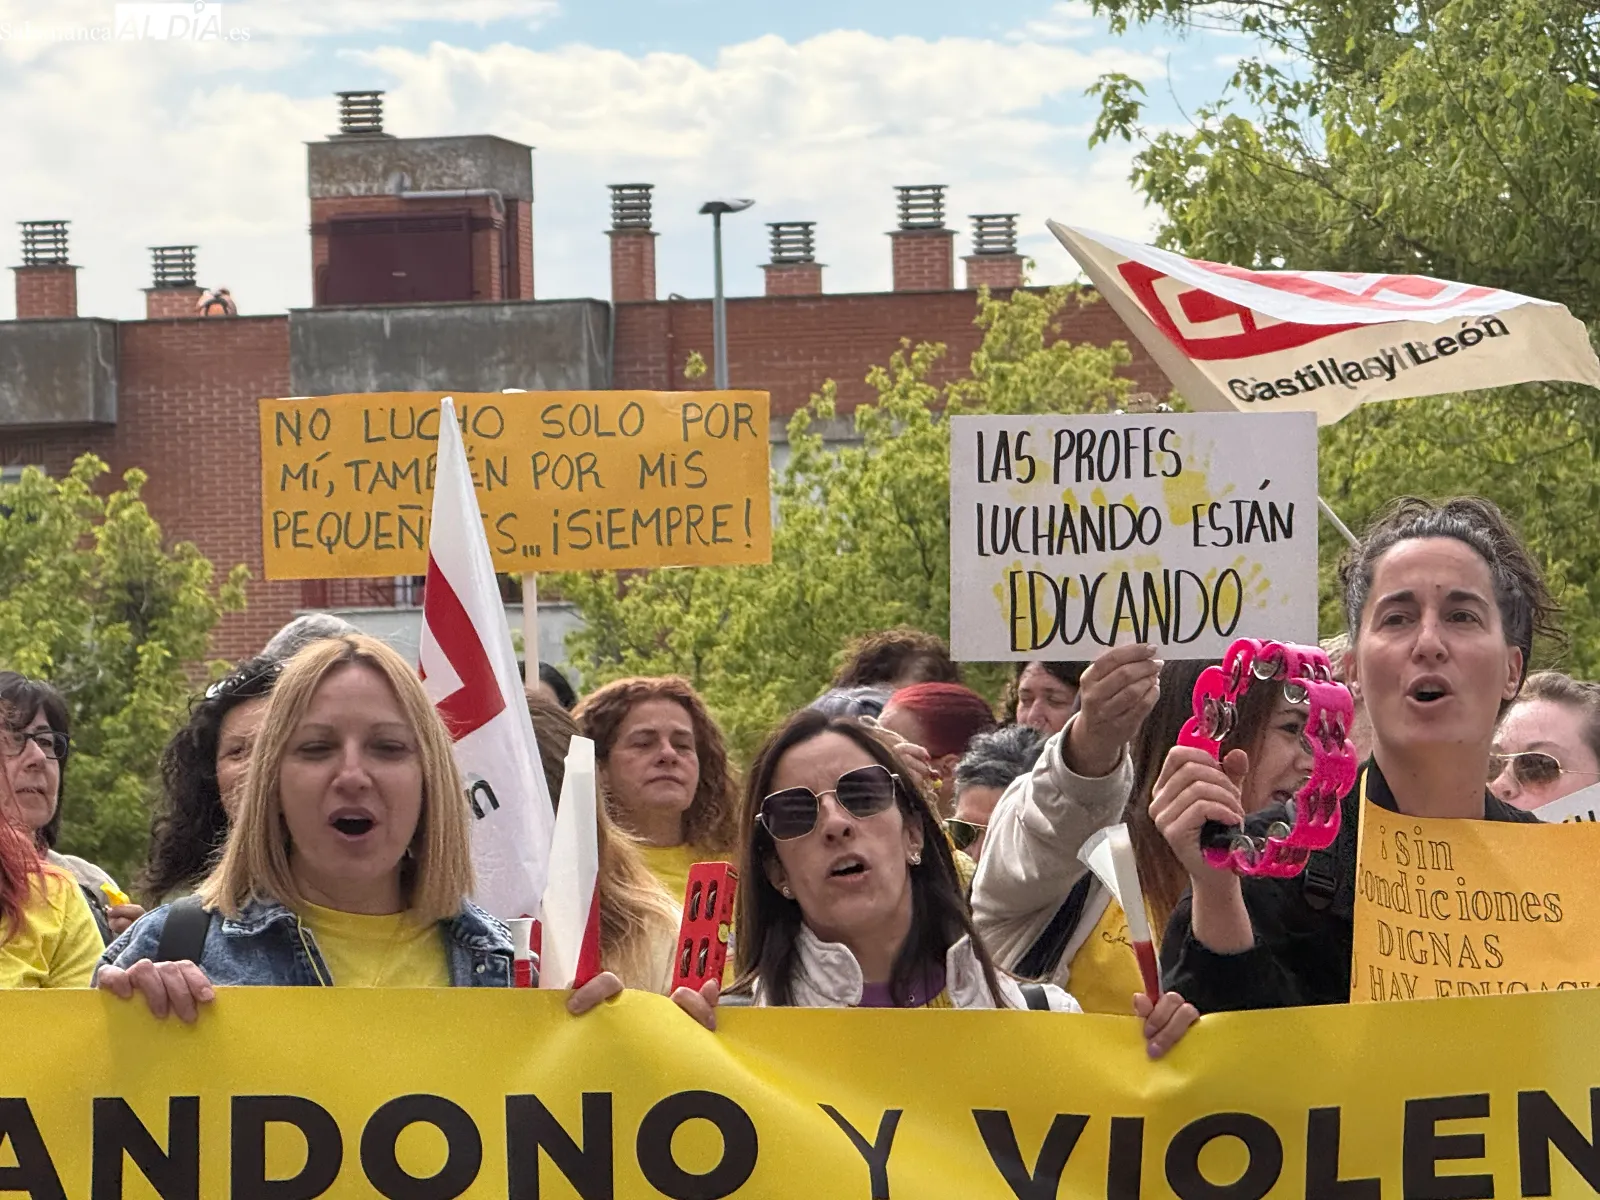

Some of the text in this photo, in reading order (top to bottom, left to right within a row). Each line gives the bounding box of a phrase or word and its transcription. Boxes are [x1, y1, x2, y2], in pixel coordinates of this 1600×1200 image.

[1227, 315, 1510, 403] Castilla y León
[276, 401, 758, 446] NO LUCHO SOLO POR
[531, 451, 606, 492] POR
[977, 426, 1182, 485] LAS PROFES
[977, 479, 1294, 557] LUCHANDO ESTÁN
[1009, 567, 1243, 652] EDUCANDO
[1377, 919, 1504, 970] DIGNAS
[1369, 964, 1418, 1001] HAY
[817, 1102, 904, 1200] Y
[971, 1087, 1600, 1200] VIOLEN
